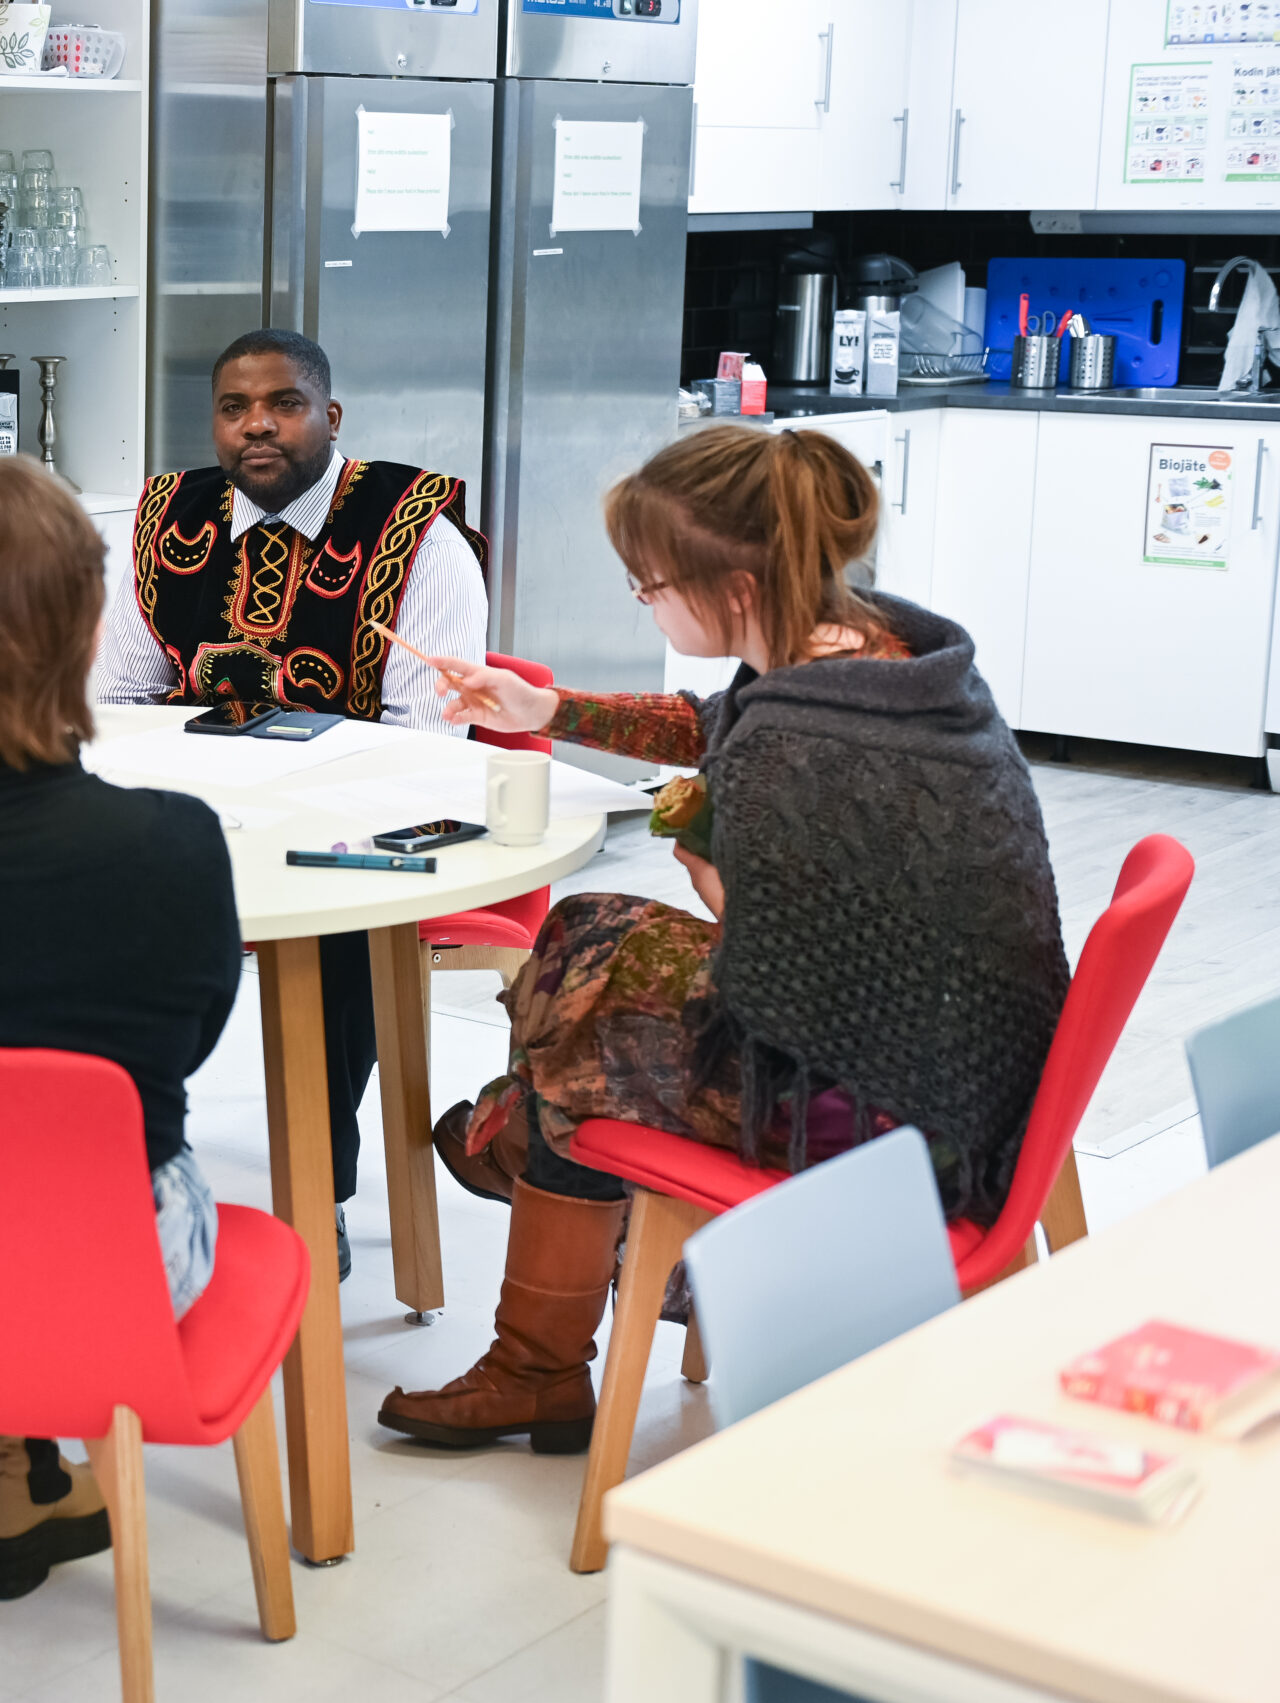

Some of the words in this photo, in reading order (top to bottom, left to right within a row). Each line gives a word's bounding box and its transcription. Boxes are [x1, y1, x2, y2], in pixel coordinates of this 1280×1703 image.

[1234, 67, 1264, 76] Kodin
[839, 335, 859, 346] LY!
[1159, 459, 1207, 473] Biojäte
